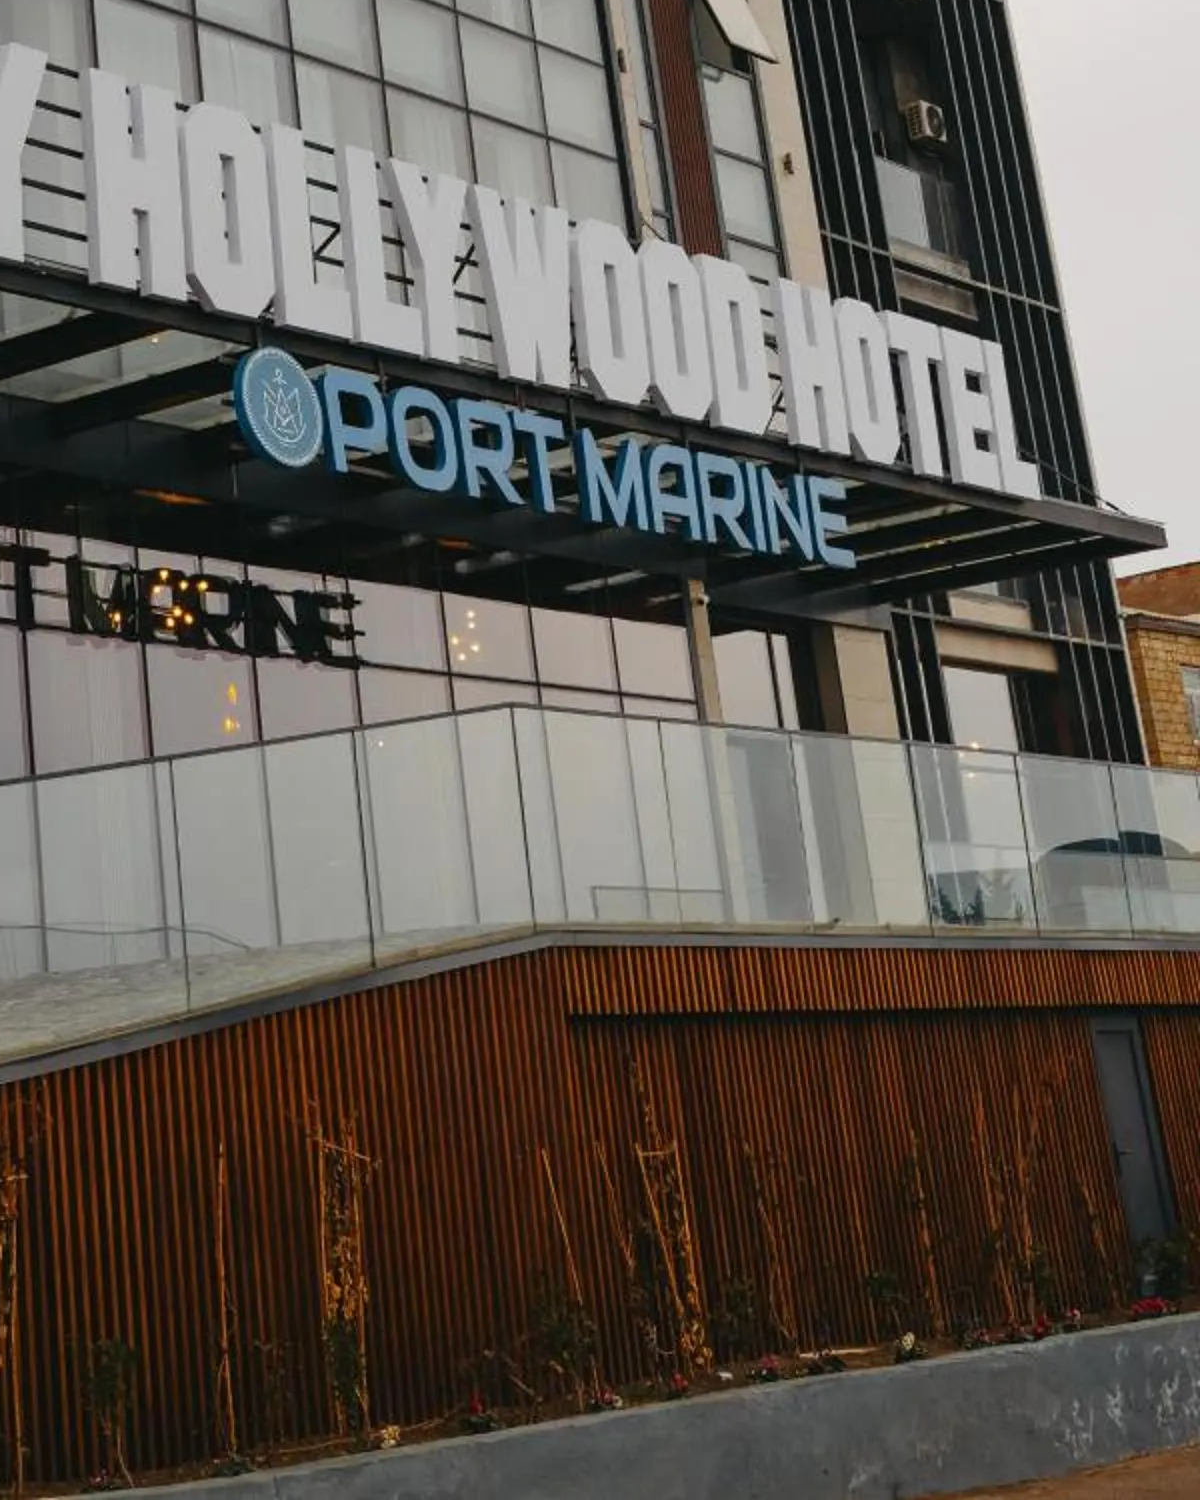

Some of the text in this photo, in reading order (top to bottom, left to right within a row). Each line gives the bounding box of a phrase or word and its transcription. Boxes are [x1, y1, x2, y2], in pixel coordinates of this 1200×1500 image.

[79, 66, 778, 435] HOLLYWOOD
[770, 276, 1042, 501] HOTEL
[309, 363, 857, 570] PORT MARINE
